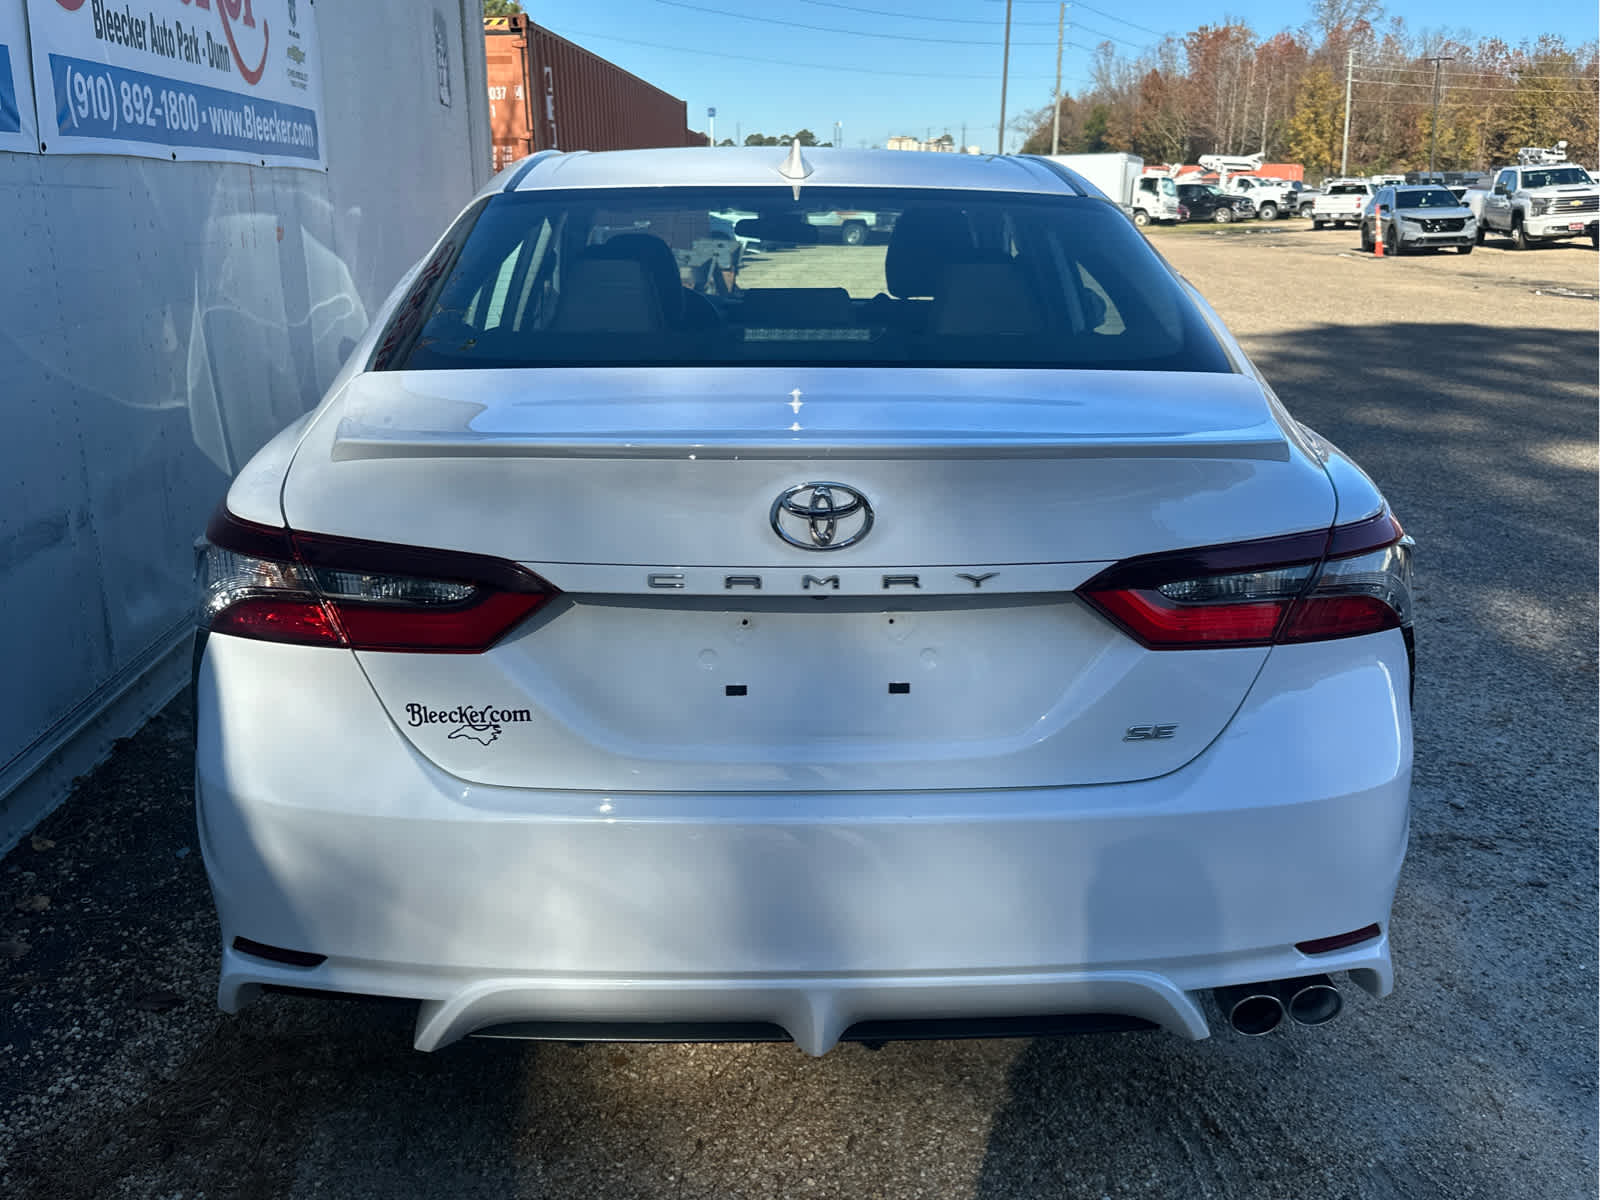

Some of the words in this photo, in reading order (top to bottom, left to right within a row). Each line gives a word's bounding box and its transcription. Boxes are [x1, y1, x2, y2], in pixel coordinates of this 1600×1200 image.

[91, 0, 147, 51] Bleecker
[149, 12, 175, 58] Auto
[176, 20, 201, 64] Park
[206, 30, 231, 72] Dunn
[66, 65, 118, 132] (910)
[120, 80, 199, 132] 892-1800
[208, 105, 314, 147] www.Bleecker.com
[647, 572, 1001, 590] CAMRY
[1122, 723, 1180, 742] SE
